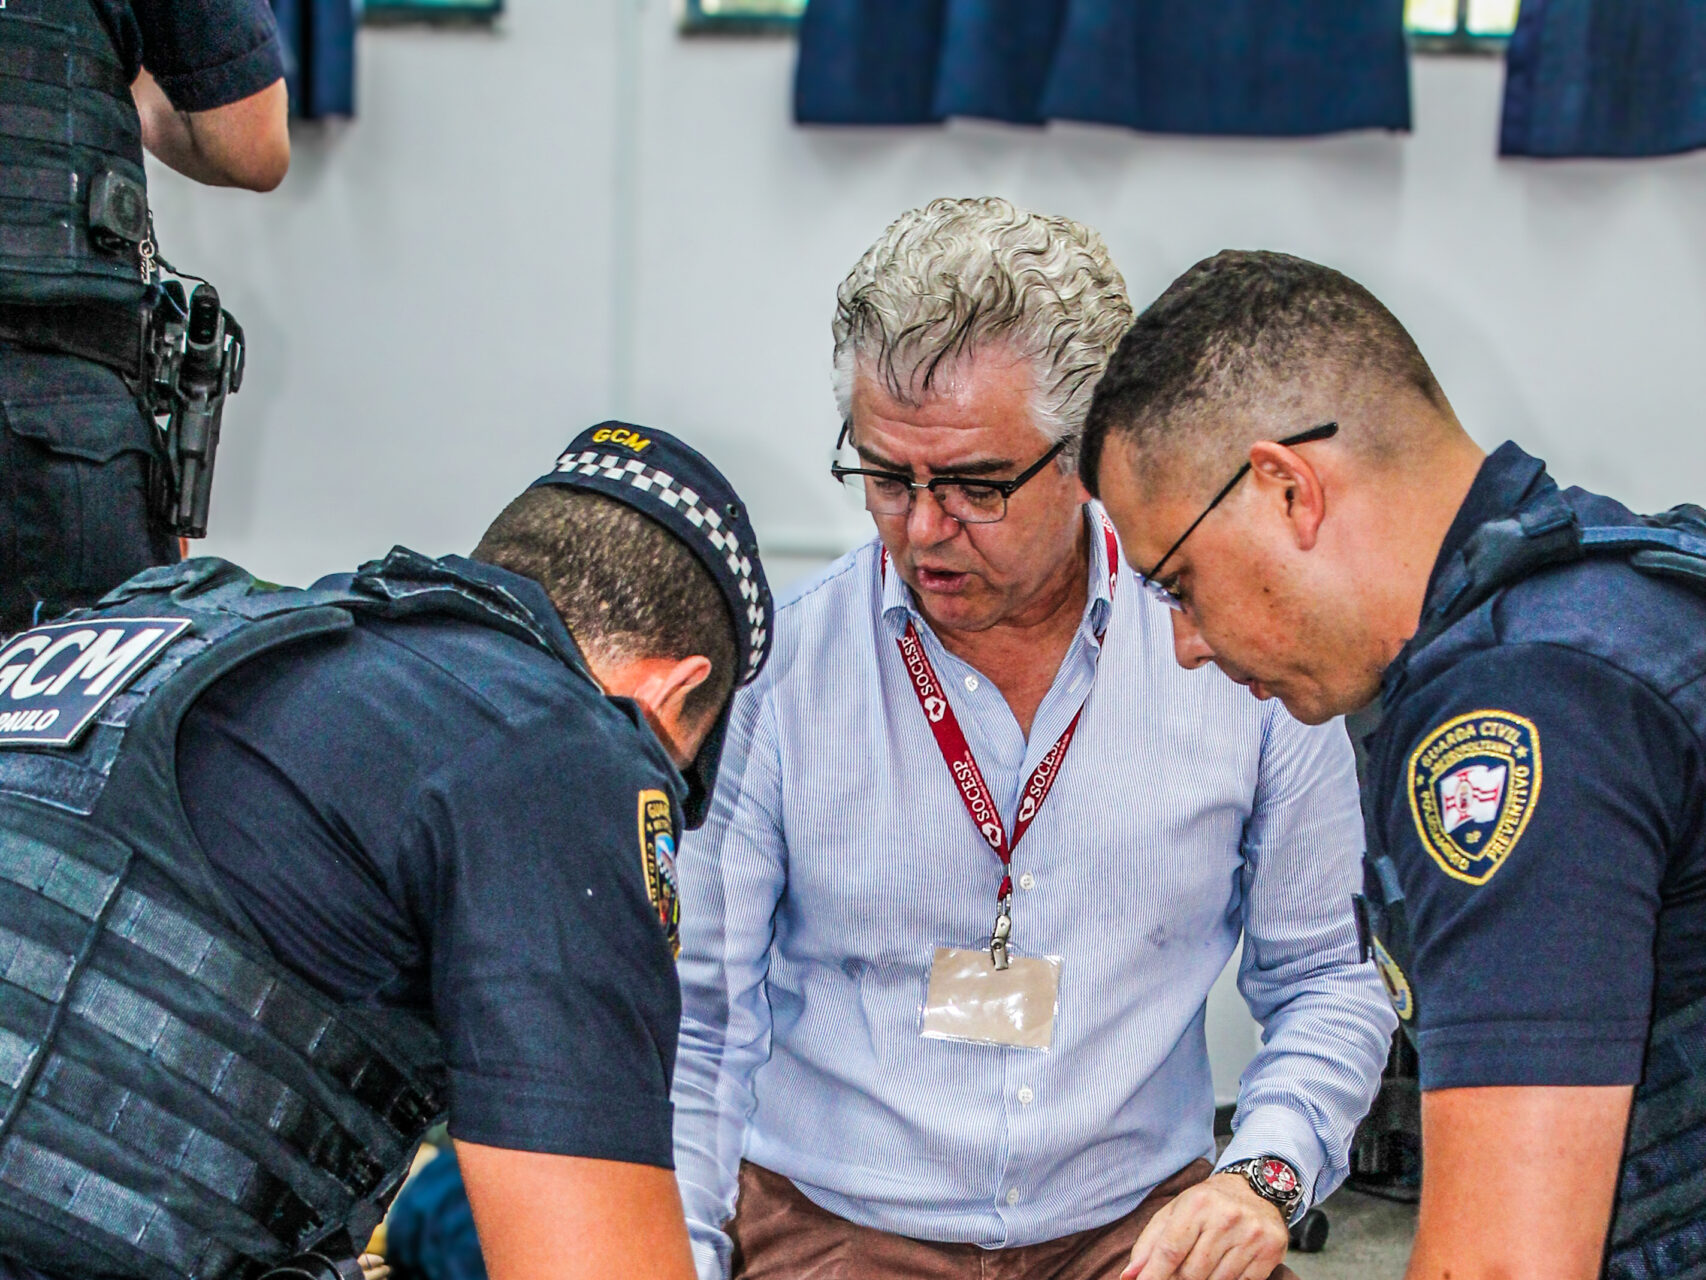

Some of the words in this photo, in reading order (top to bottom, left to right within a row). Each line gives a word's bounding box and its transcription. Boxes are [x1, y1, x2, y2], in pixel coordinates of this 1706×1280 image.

[592, 428, 651, 452] GCM
[0, 629, 166, 700] GCM
[901, 637, 934, 696] SOCESP
[953, 760, 990, 822] SOCESP
